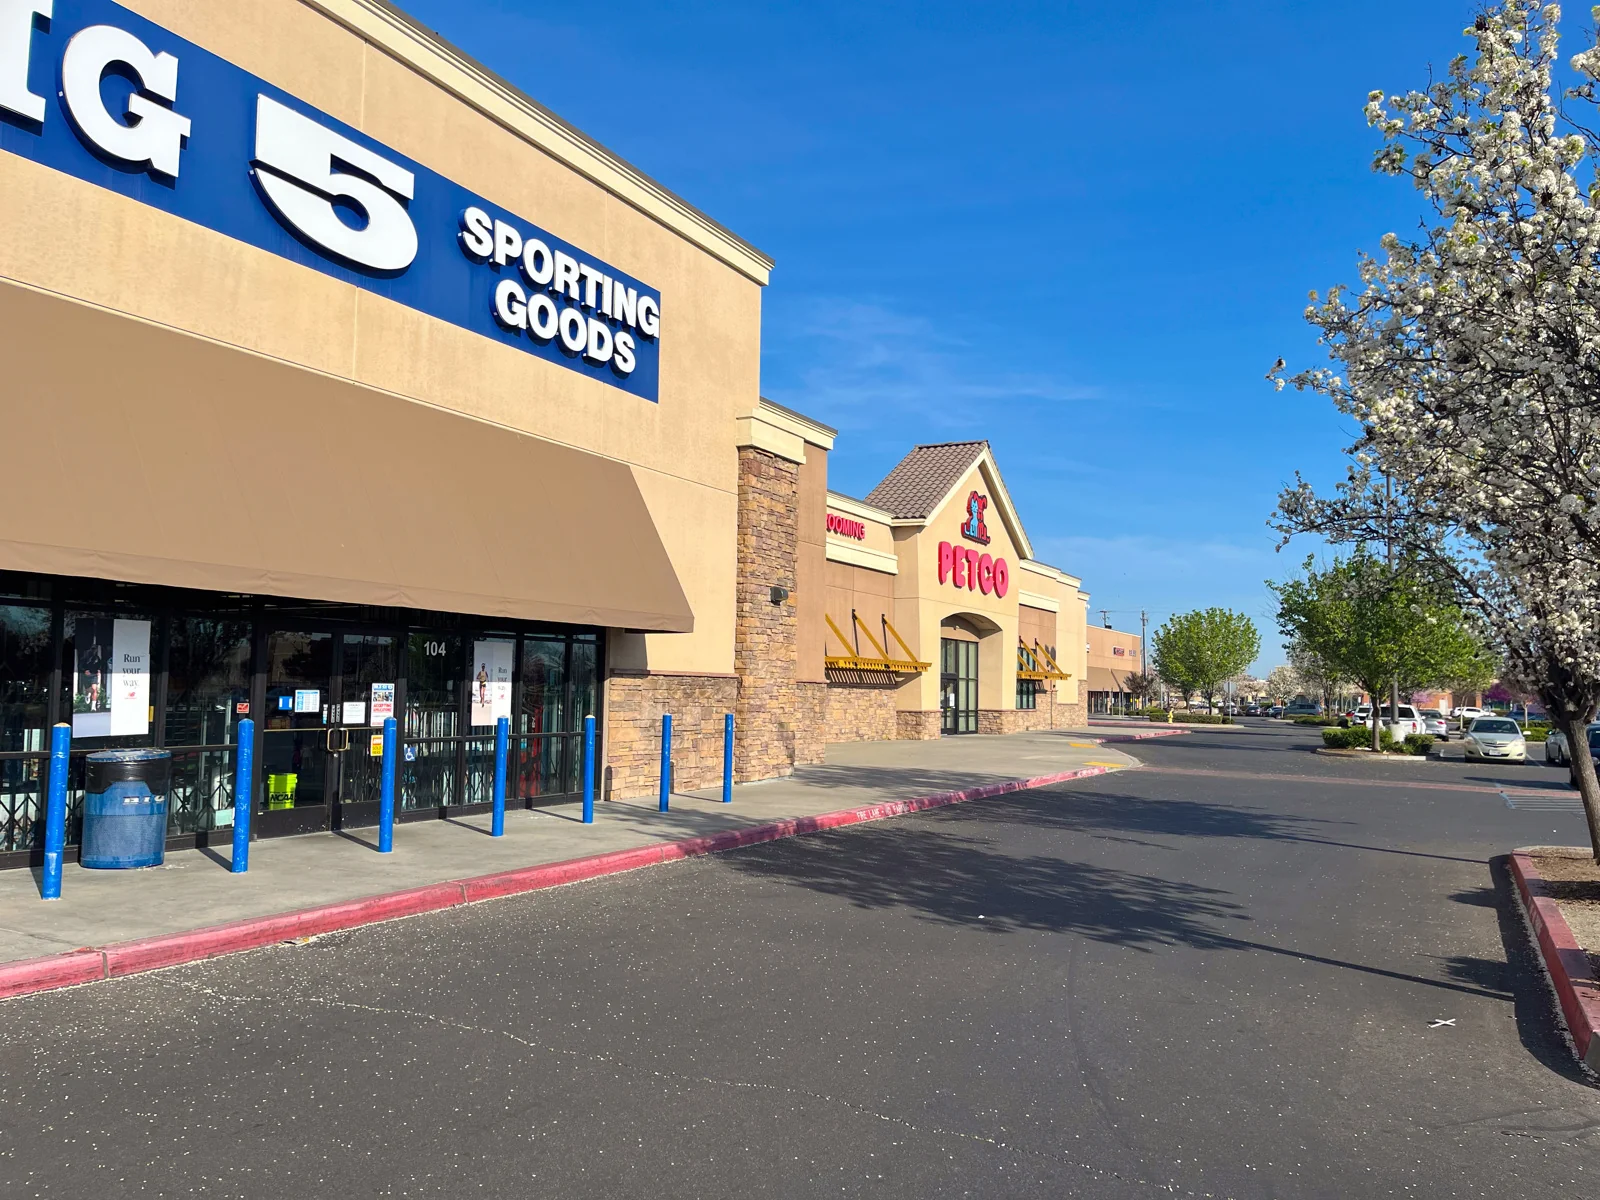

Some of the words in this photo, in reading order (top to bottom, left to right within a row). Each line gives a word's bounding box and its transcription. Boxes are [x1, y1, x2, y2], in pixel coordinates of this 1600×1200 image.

[251, 93, 418, 270] 5
[458, 206, 660, 338] SPORTING
[493, 279, 636, 374] GOODS
[825, 513, 865, 539] OOMING
[938, 541, 1009, 599] PETCO
[123, 654, 141, 663] Run
[424, 641, 446, 656] 104
[122, 667, 141, 677] your
[270, 793, 294, 802] NCAA
